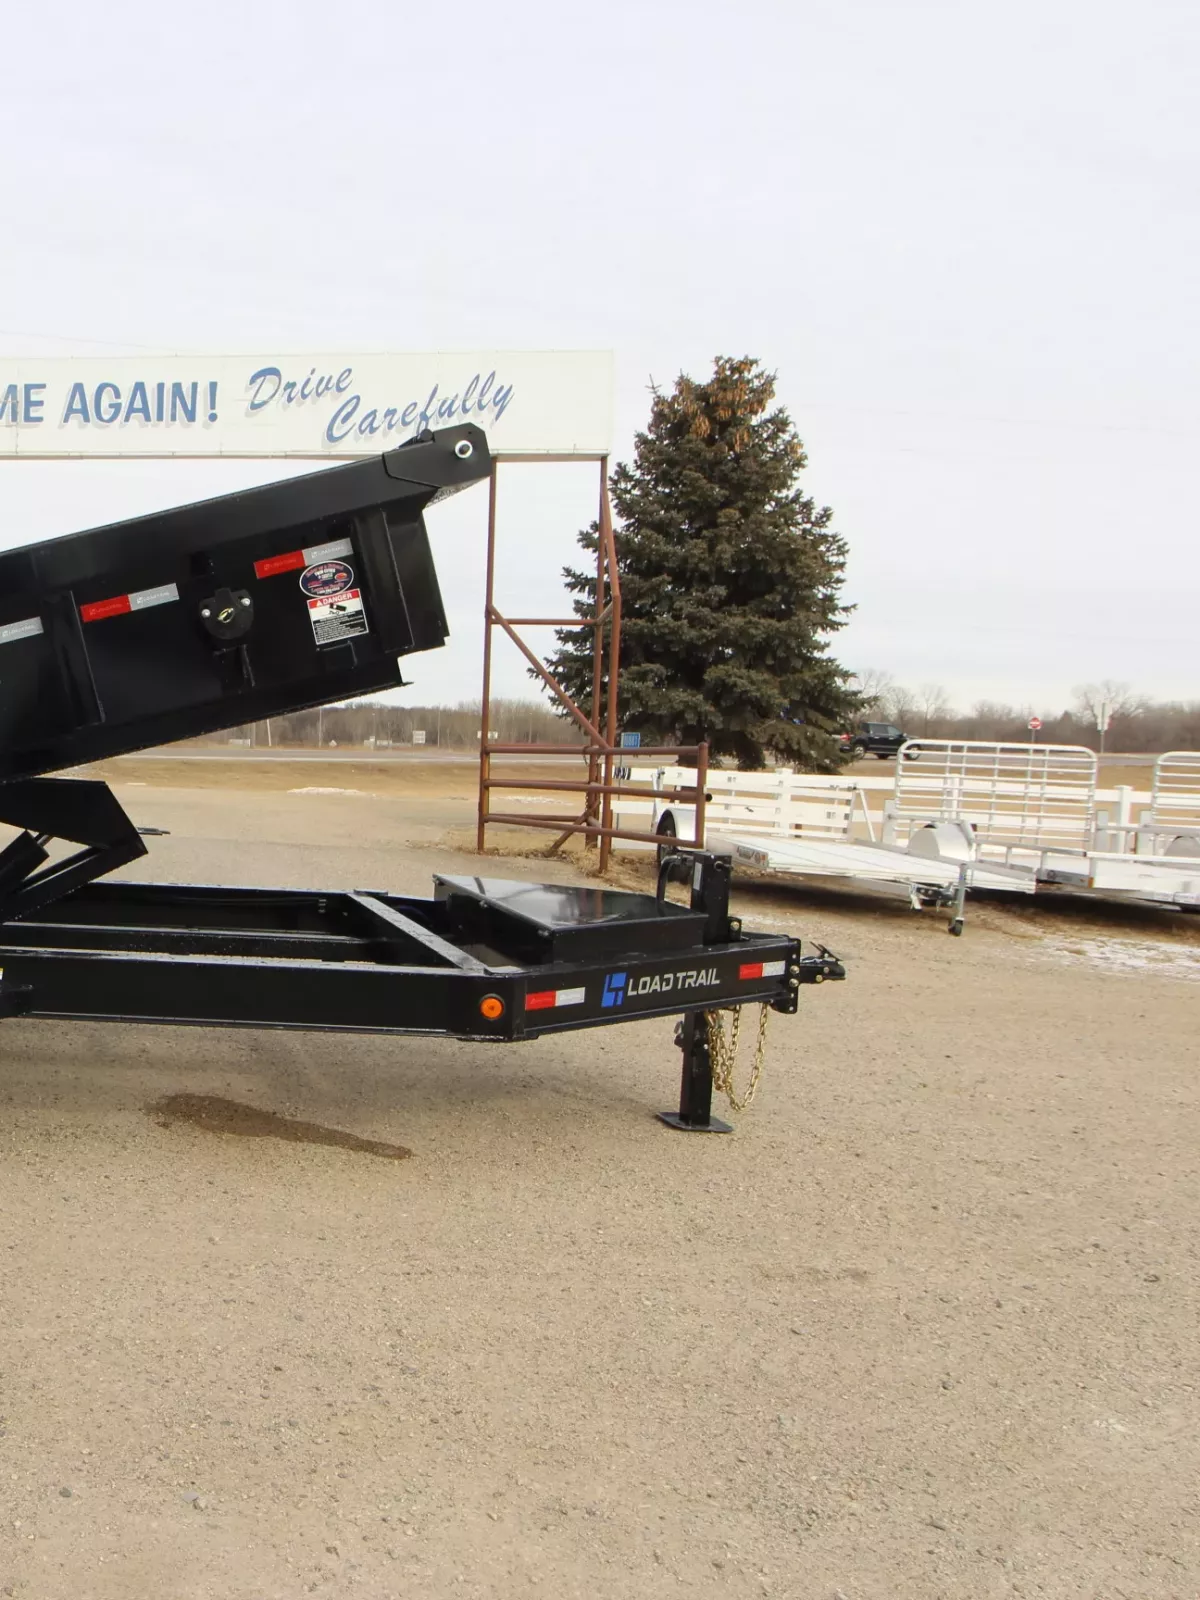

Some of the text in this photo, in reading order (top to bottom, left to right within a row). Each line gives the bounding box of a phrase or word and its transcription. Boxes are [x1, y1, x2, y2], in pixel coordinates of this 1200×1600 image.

[62, 381, 219, 423] AGAIN!
[248, 366, 354, 411] Drive
[325, 370, 515, 443] Carefully
[322, 591, 353, 605] DANGER
[626, 967, 721, 997] LOAD TRAIL
